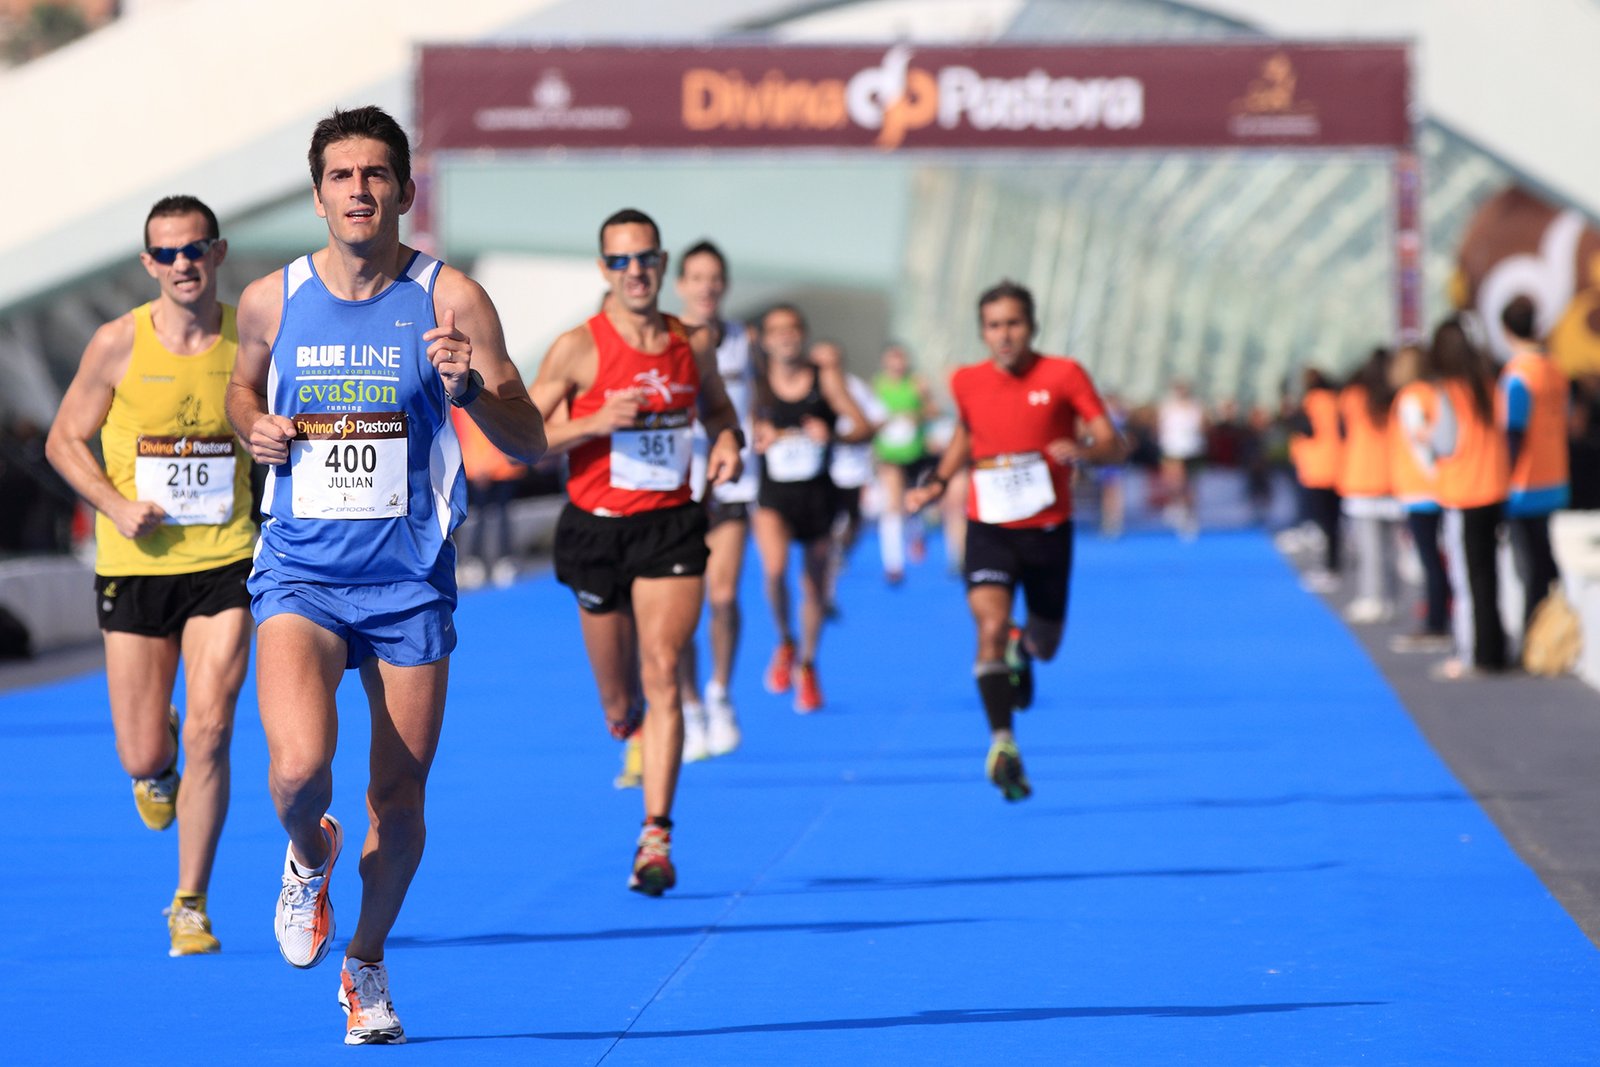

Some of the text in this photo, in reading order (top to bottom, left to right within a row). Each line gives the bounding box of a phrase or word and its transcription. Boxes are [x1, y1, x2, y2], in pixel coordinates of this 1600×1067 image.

[681, 67, 846, 130] Divina
[937, 65, 1144, 131] Pastora
[296, 345, 401, 368] BLUE LINE
[301, 367, 396, 376] runner's community
[297, 421, 333, 434] Divina
[356, 420, 403, 433] Pastora
[140, 441, 174, 454] Divina
[193, 441, 232, 454] Pastora
[639, 434, 675, 456] 361
[325, 444, 377, 473] 400
[167, 463, 209, 486] 216
[328, 477, 373, 488] JULIAN
